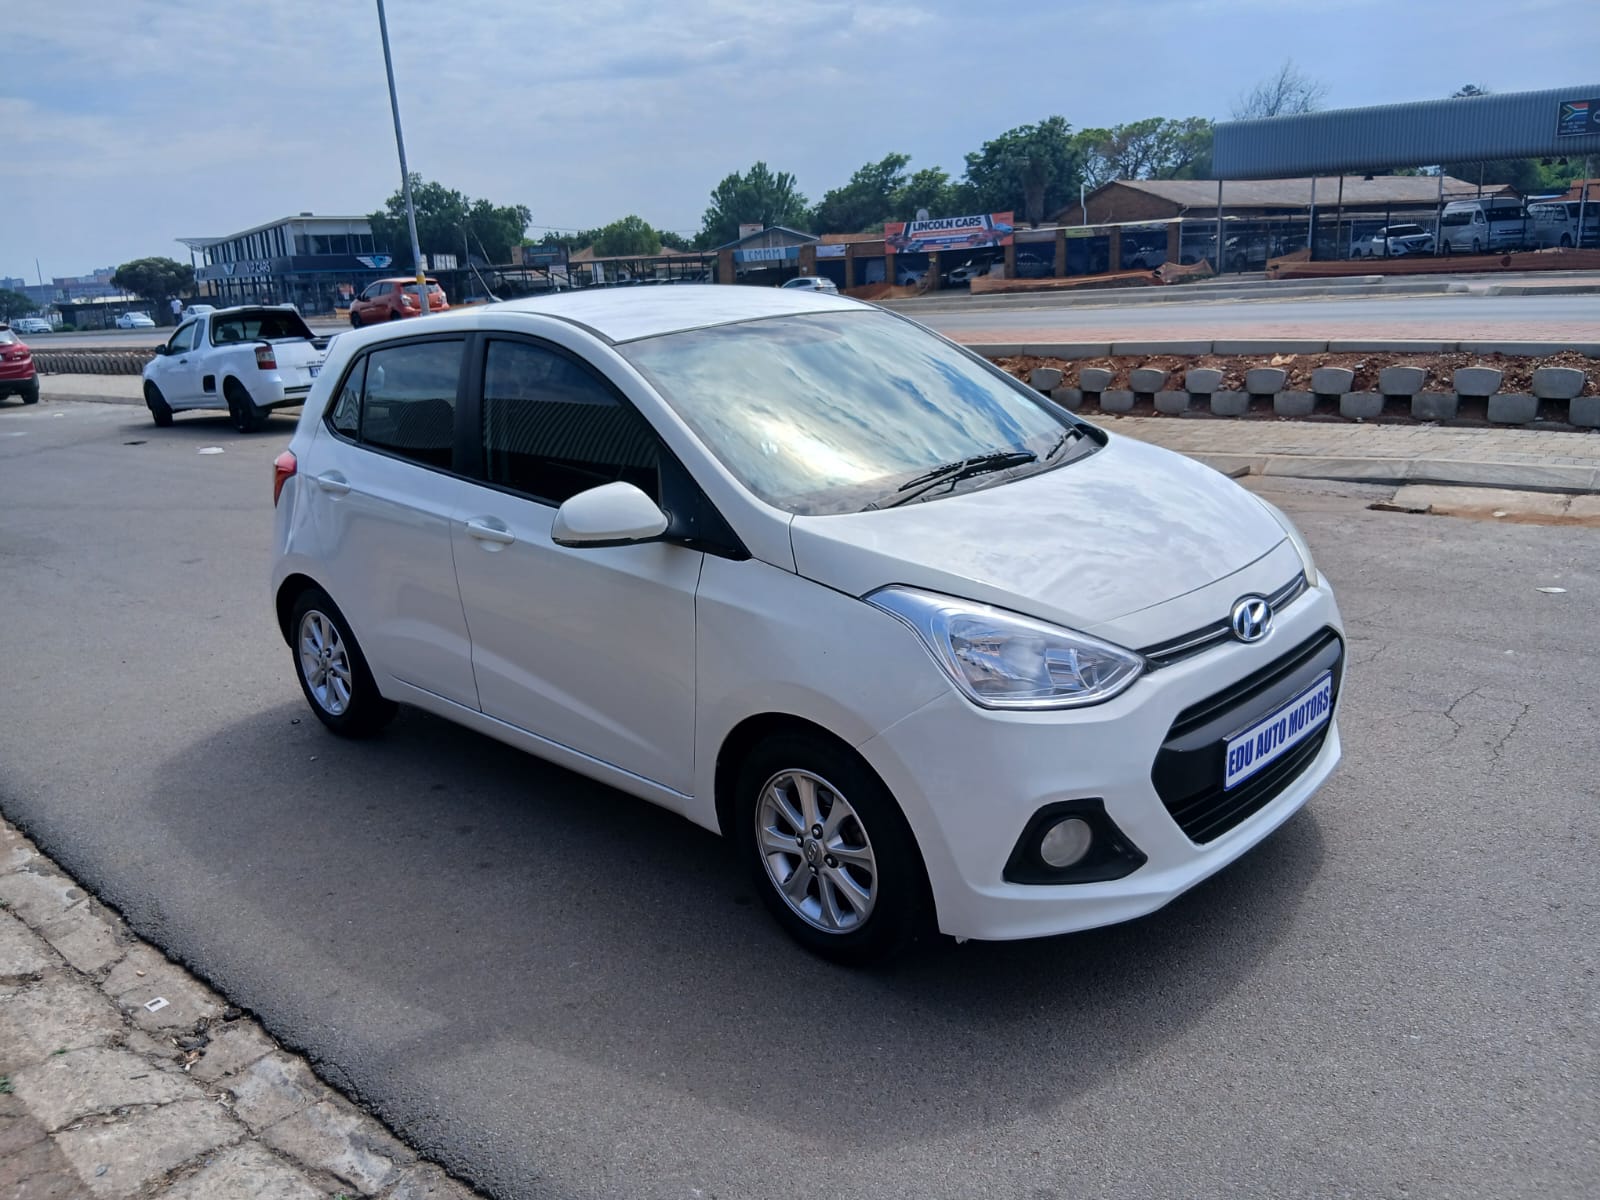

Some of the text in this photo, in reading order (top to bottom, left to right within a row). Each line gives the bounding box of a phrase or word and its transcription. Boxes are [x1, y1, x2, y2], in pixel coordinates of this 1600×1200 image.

[913, 217, 981, 231] LINCOLN CARS
[1228, 687, 1329, 777] EDU AUTO MOTORS
